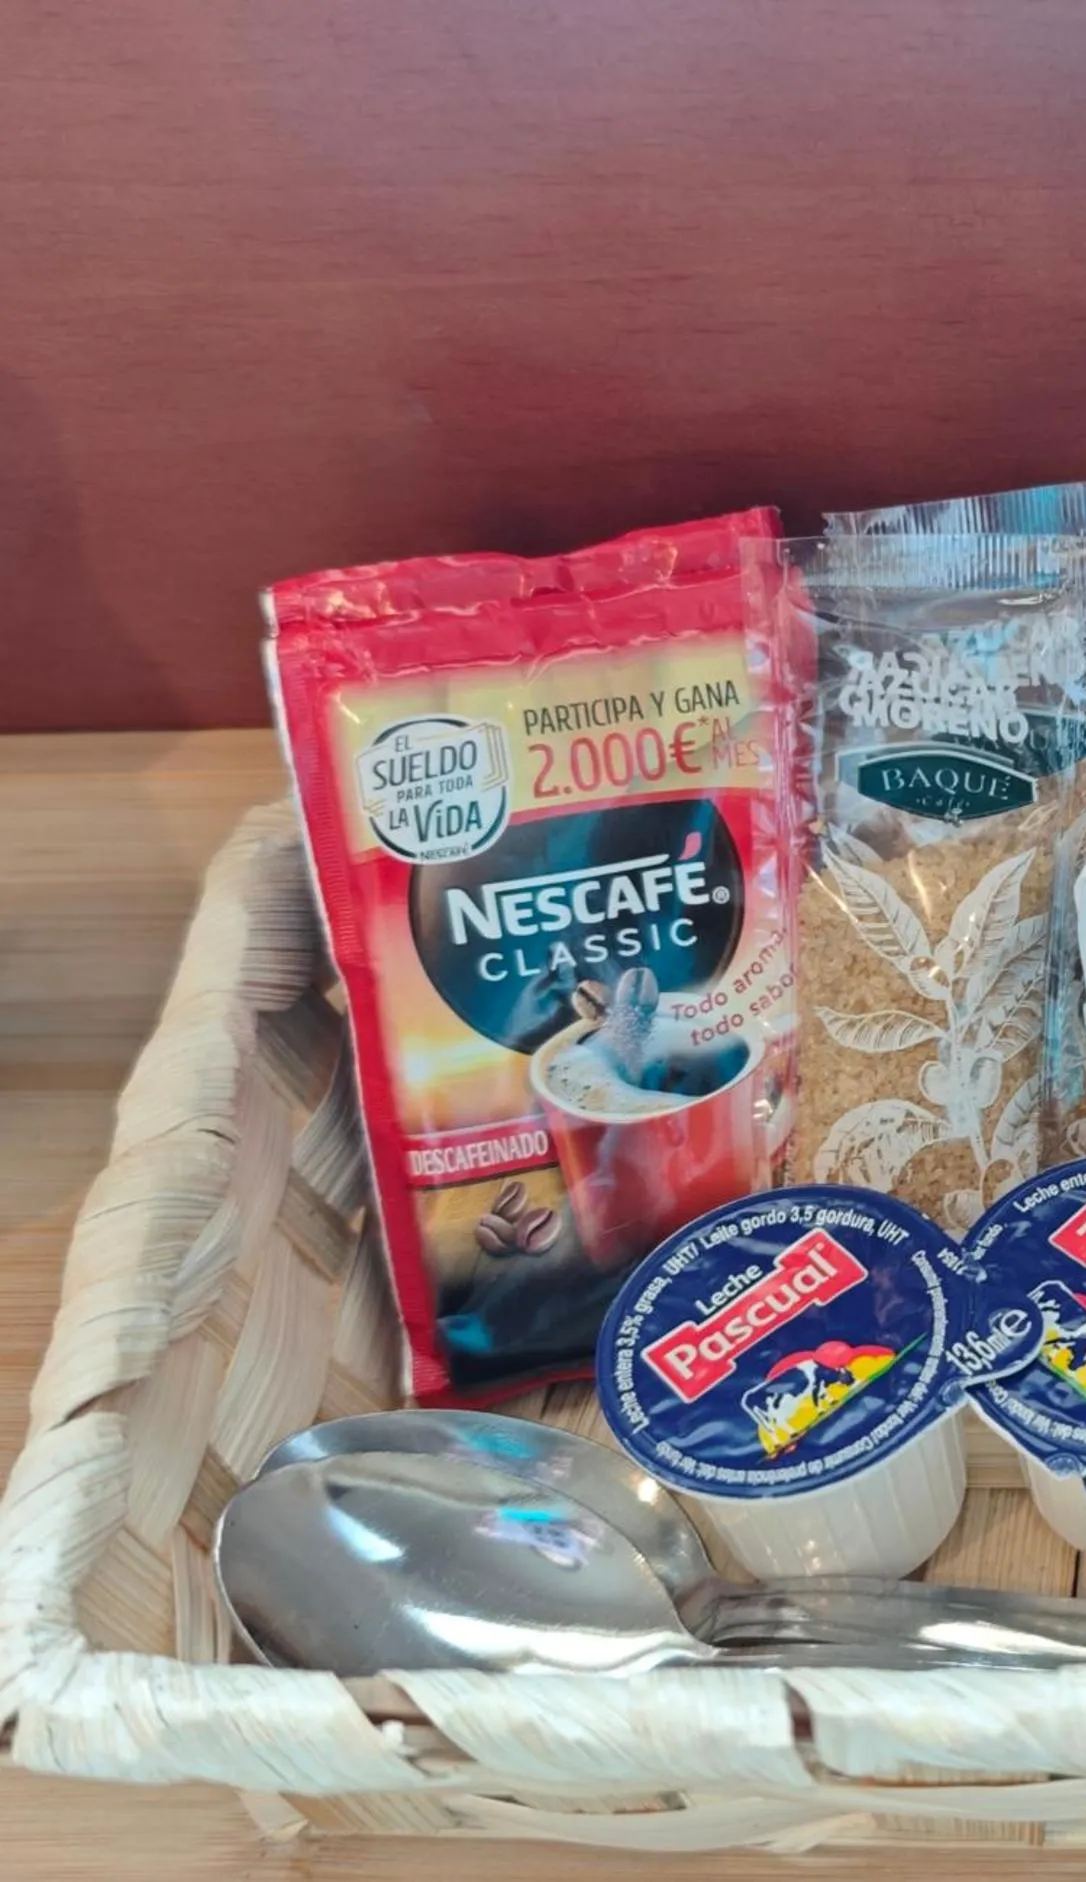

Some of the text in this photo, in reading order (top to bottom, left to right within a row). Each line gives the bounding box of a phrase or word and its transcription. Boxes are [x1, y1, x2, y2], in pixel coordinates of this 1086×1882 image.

[523, 680, 741, 736] PARTICIPA Y GANA
[394, 735, 413, 753] EL
[711, 717, 737, 741] AL
[371, 739, 478, 791] SUELDO
[711, 740, 760, 770] MES
[397, 775, 474, 802] PARA TODA
[389, 808, 410, 830] LA
[478, 918, 699, 982] CLASSIC
[670, 992, 729, 1021] Todo
[690, 1013, 745, 1046] todo
[408, 1129, 550, 1177] DESCAFEINADO
[1012, 1182, 1059, 1214] Leche
[740, 1209, 787, 1236] gordo
[815, 1207, 875, 1238] gordura,
[877, 1219, 911, 1247] UHT
[694, 1263, 764, 1316] Leche
[663, 1246, 840, 1381] Pascual
